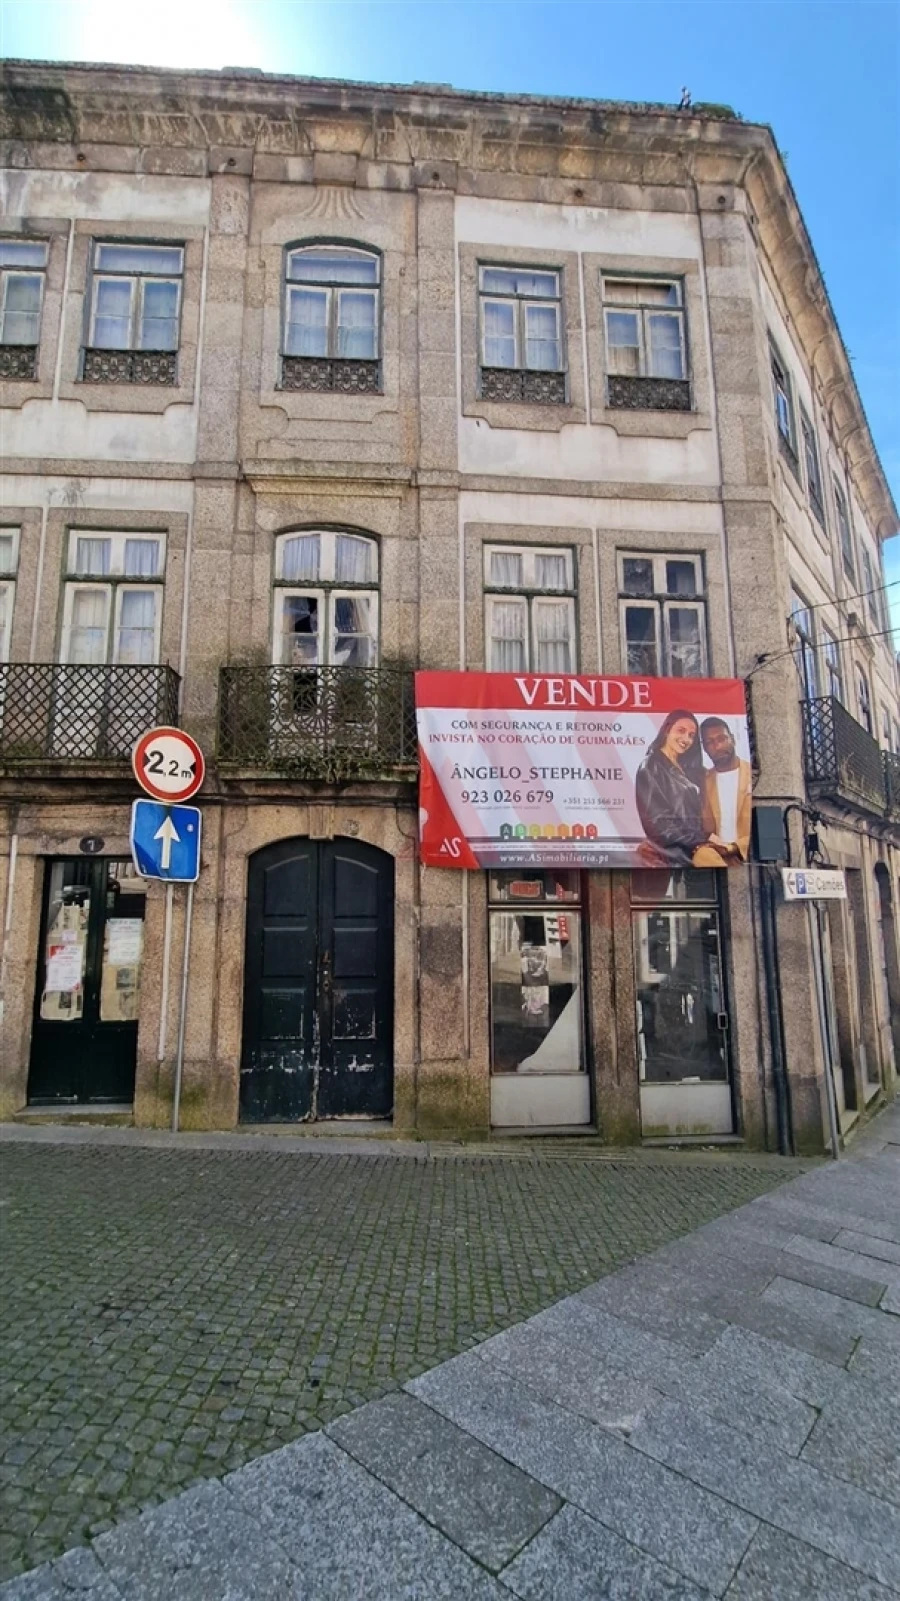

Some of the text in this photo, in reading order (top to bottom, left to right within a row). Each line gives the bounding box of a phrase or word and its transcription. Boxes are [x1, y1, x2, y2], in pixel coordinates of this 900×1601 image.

[514, 678, 652, 708] VENDE
[451, 720, 622, 732] COM SEGURANÇA E RETORNO
[429, 733, 646, 746] INVISTA NO CORAÇÃO DE GUIMARÃES
[450, 763, 624, 783] ÂNGELO_STEPHANIE
[461, 789, 554, 803] 923 026 679
[500, 852, 609, 865] www.ASimobiliaria.pt
